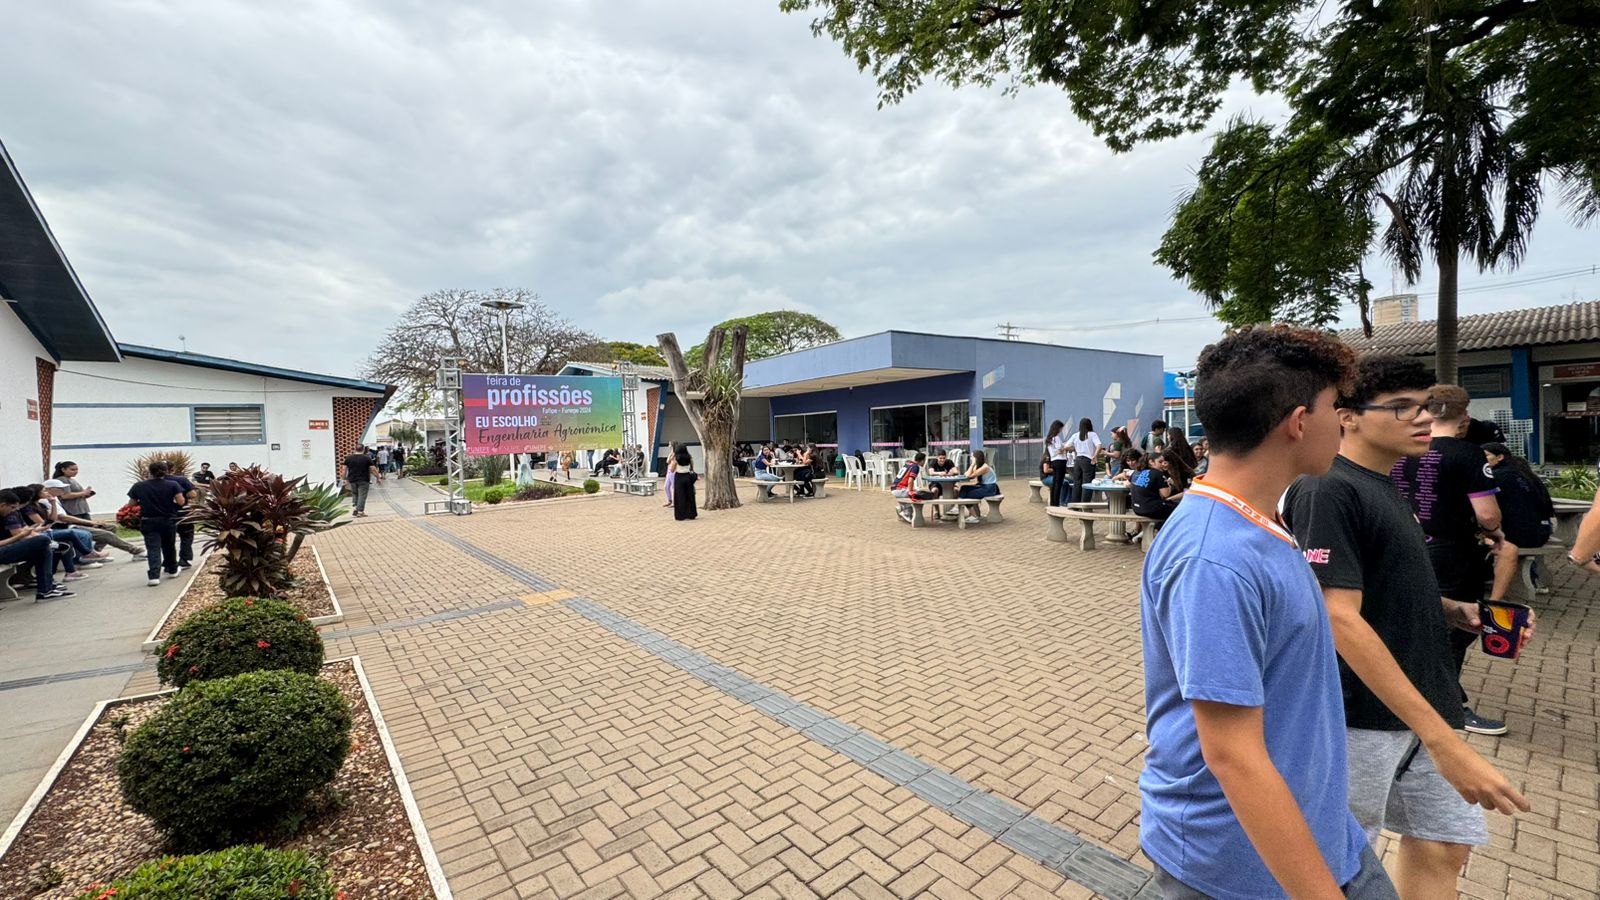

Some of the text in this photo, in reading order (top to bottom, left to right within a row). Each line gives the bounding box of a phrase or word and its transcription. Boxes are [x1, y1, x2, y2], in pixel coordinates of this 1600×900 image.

[486, 376, 521, 386] feira de
[487, 384, 593, 410] profissões
[475, 416, 490, 428] EU
[492, 415, 538, 428] ESCOLHO
[478, 426, 549, 449] Engenharia
